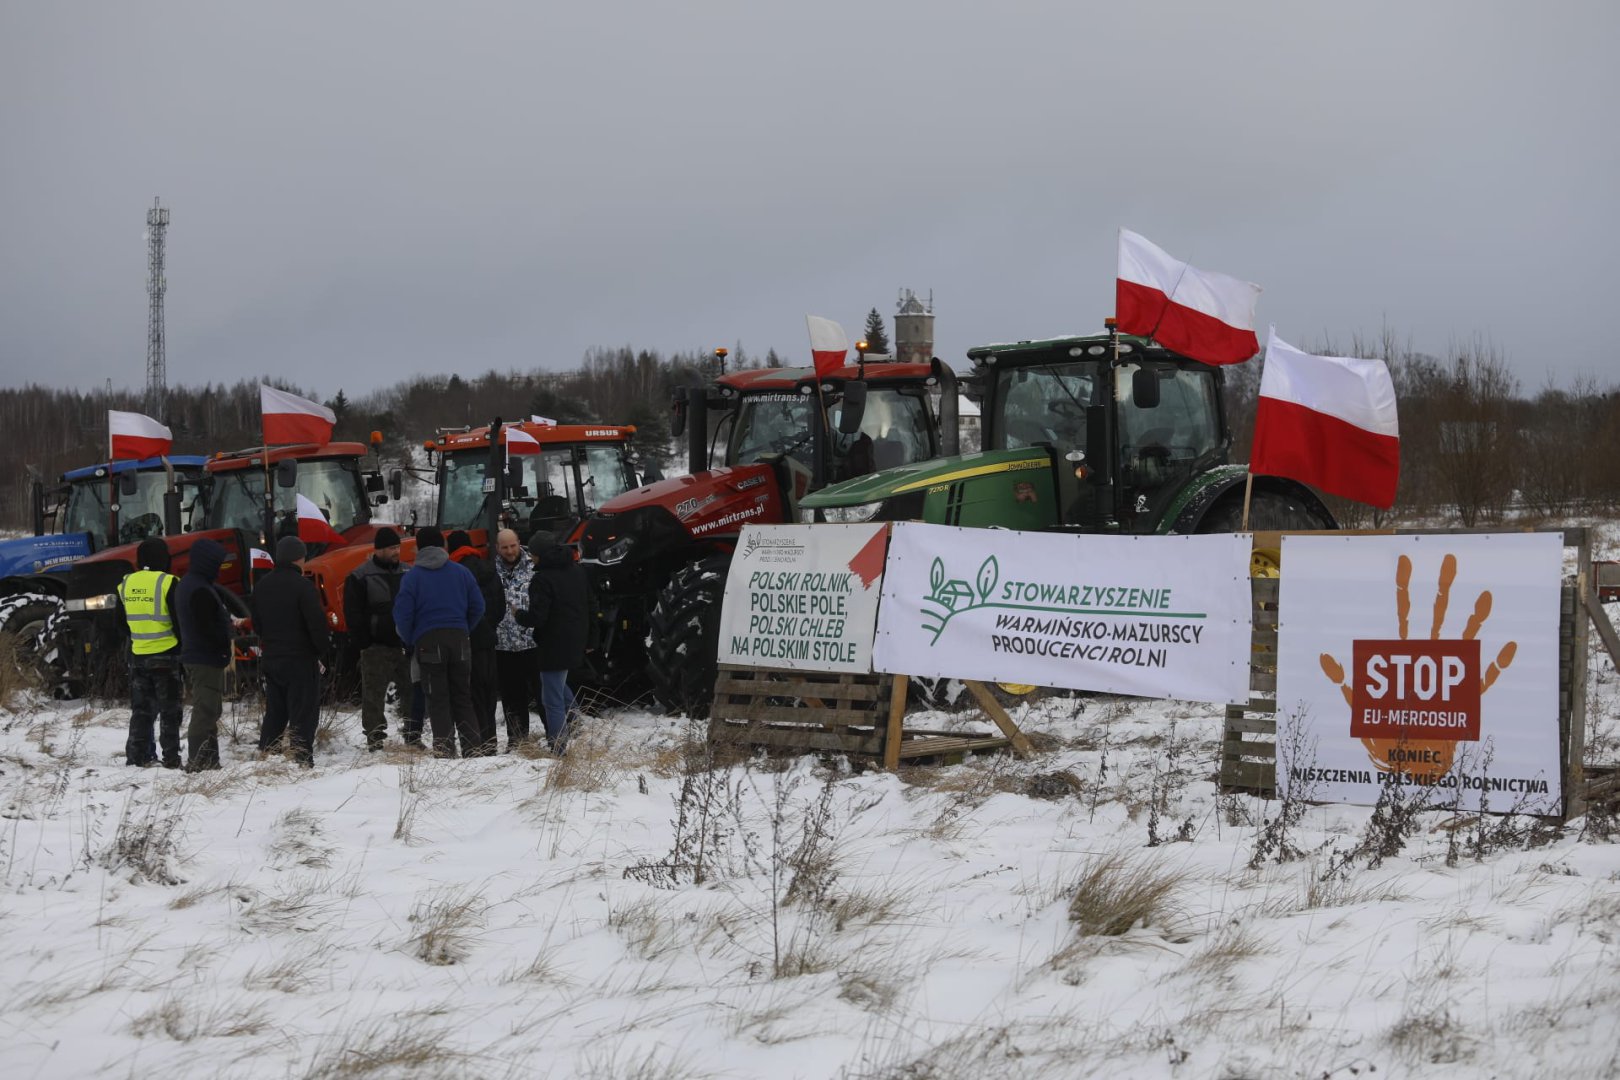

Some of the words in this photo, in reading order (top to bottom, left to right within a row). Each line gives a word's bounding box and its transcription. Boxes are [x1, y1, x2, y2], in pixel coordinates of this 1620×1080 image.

[742, 392, 810, 404] www.mirtrans.pl
[692, 503, 765, 535] www.mirtrans.pl
[749, 571, 799, 592] POLSKI
[801, 573, 852, 596] ROLNIK,
[1001, 581, 1171, 608] STOWARZYSZENIE
[751, 592, 806, 614] POLSKIE
[811, 595, 848, 619] POLE,
[750, 615, 796, 636] POLSKI
[800, 618, 844, 639] CHLEB
[731, 636, 749, 657] NA
[752, 637, 809, 661] POLSKIM
[813, 641, 857, 663] STOLE
[992, 635, 1106, 661] PRODUCENCI
[1107, 647, 1167, 668] ROLNI
[1365, 654, 1466, 701] STOP
[1363, 708, 1467, 728] EU-MERCOSUR
[1388, 749, 1441, 764] KONIEC
[1291, 767, 1371, 784] NISZCZENIA
[1377, 771, 1457, 788] POLSKIEGO
[1463, 776, 1549, 793] ROLNICTWA
